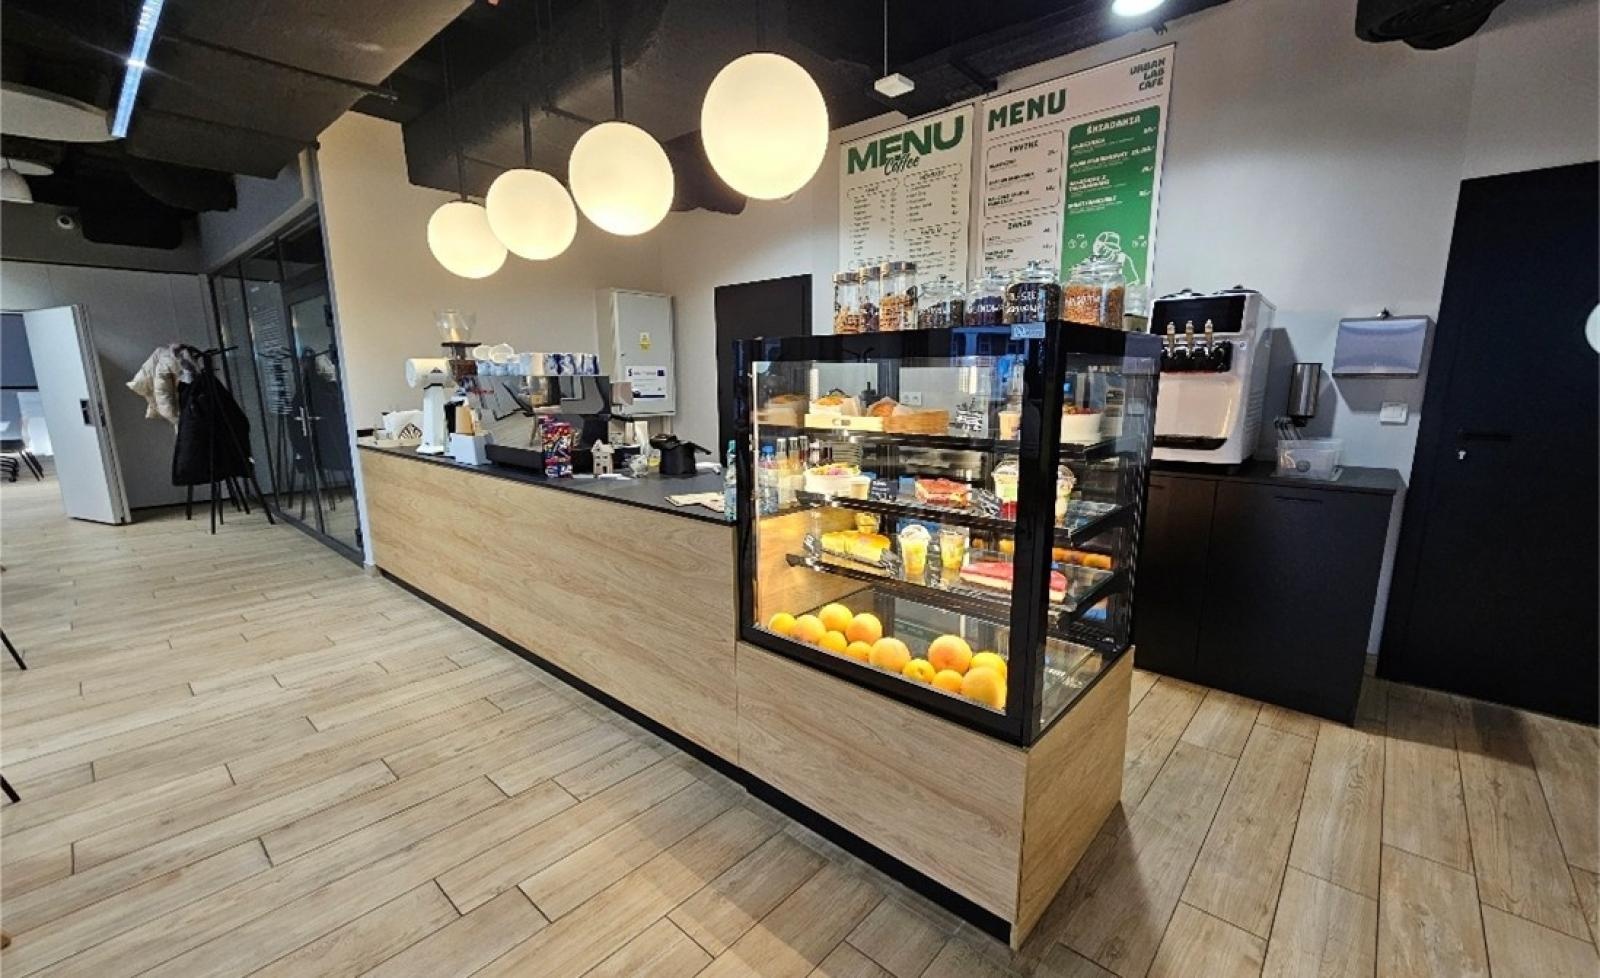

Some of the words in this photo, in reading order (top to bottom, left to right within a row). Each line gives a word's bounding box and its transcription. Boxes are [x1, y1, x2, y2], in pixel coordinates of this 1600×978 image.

[1129, 57, 1166, 75] URBAN
[1143, 67, 1166, 81] LAB
[1139, 76, 1163, 90] CAFE
[987, 88, 1066, 132] MENU
[847, 115, 964, 175] MENU
[884, 152, 920, 176] Coffee
